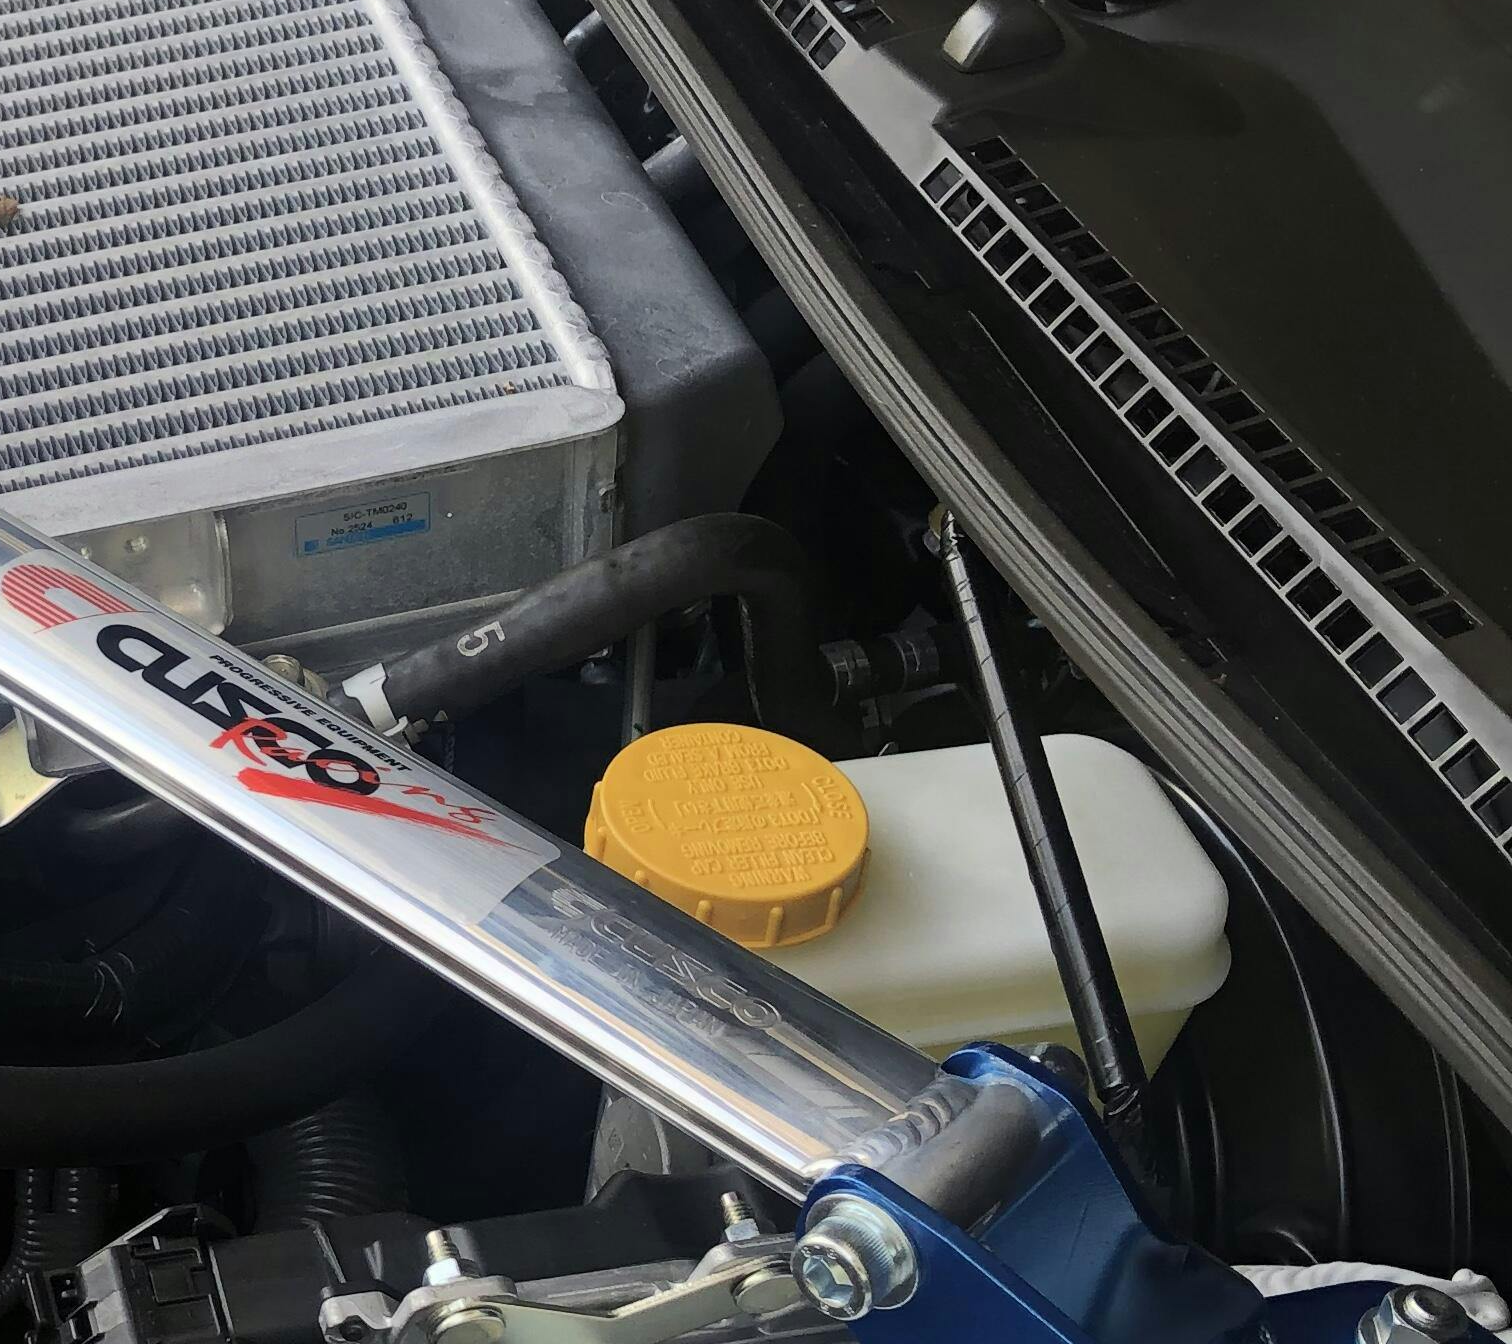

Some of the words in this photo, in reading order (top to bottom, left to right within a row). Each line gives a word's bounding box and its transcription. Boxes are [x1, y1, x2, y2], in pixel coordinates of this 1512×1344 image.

[456, 620, 507, 658] 5
[96, 623, 381, 796] CUSCO
[209, 654, 313, 718] PROGRESSIVE
[315, 714, 413, 773] EQUIPMENT
[766, 830, 828, 850] BEFORE
[689, 858, 720, 875] CAP
[728, 852, 777, 870] FILLER
[780, 846, 835, 867] CLEAN
[729, 864, 812, 888] WARNING
[589, 908, 782, 1029] CUSCO
